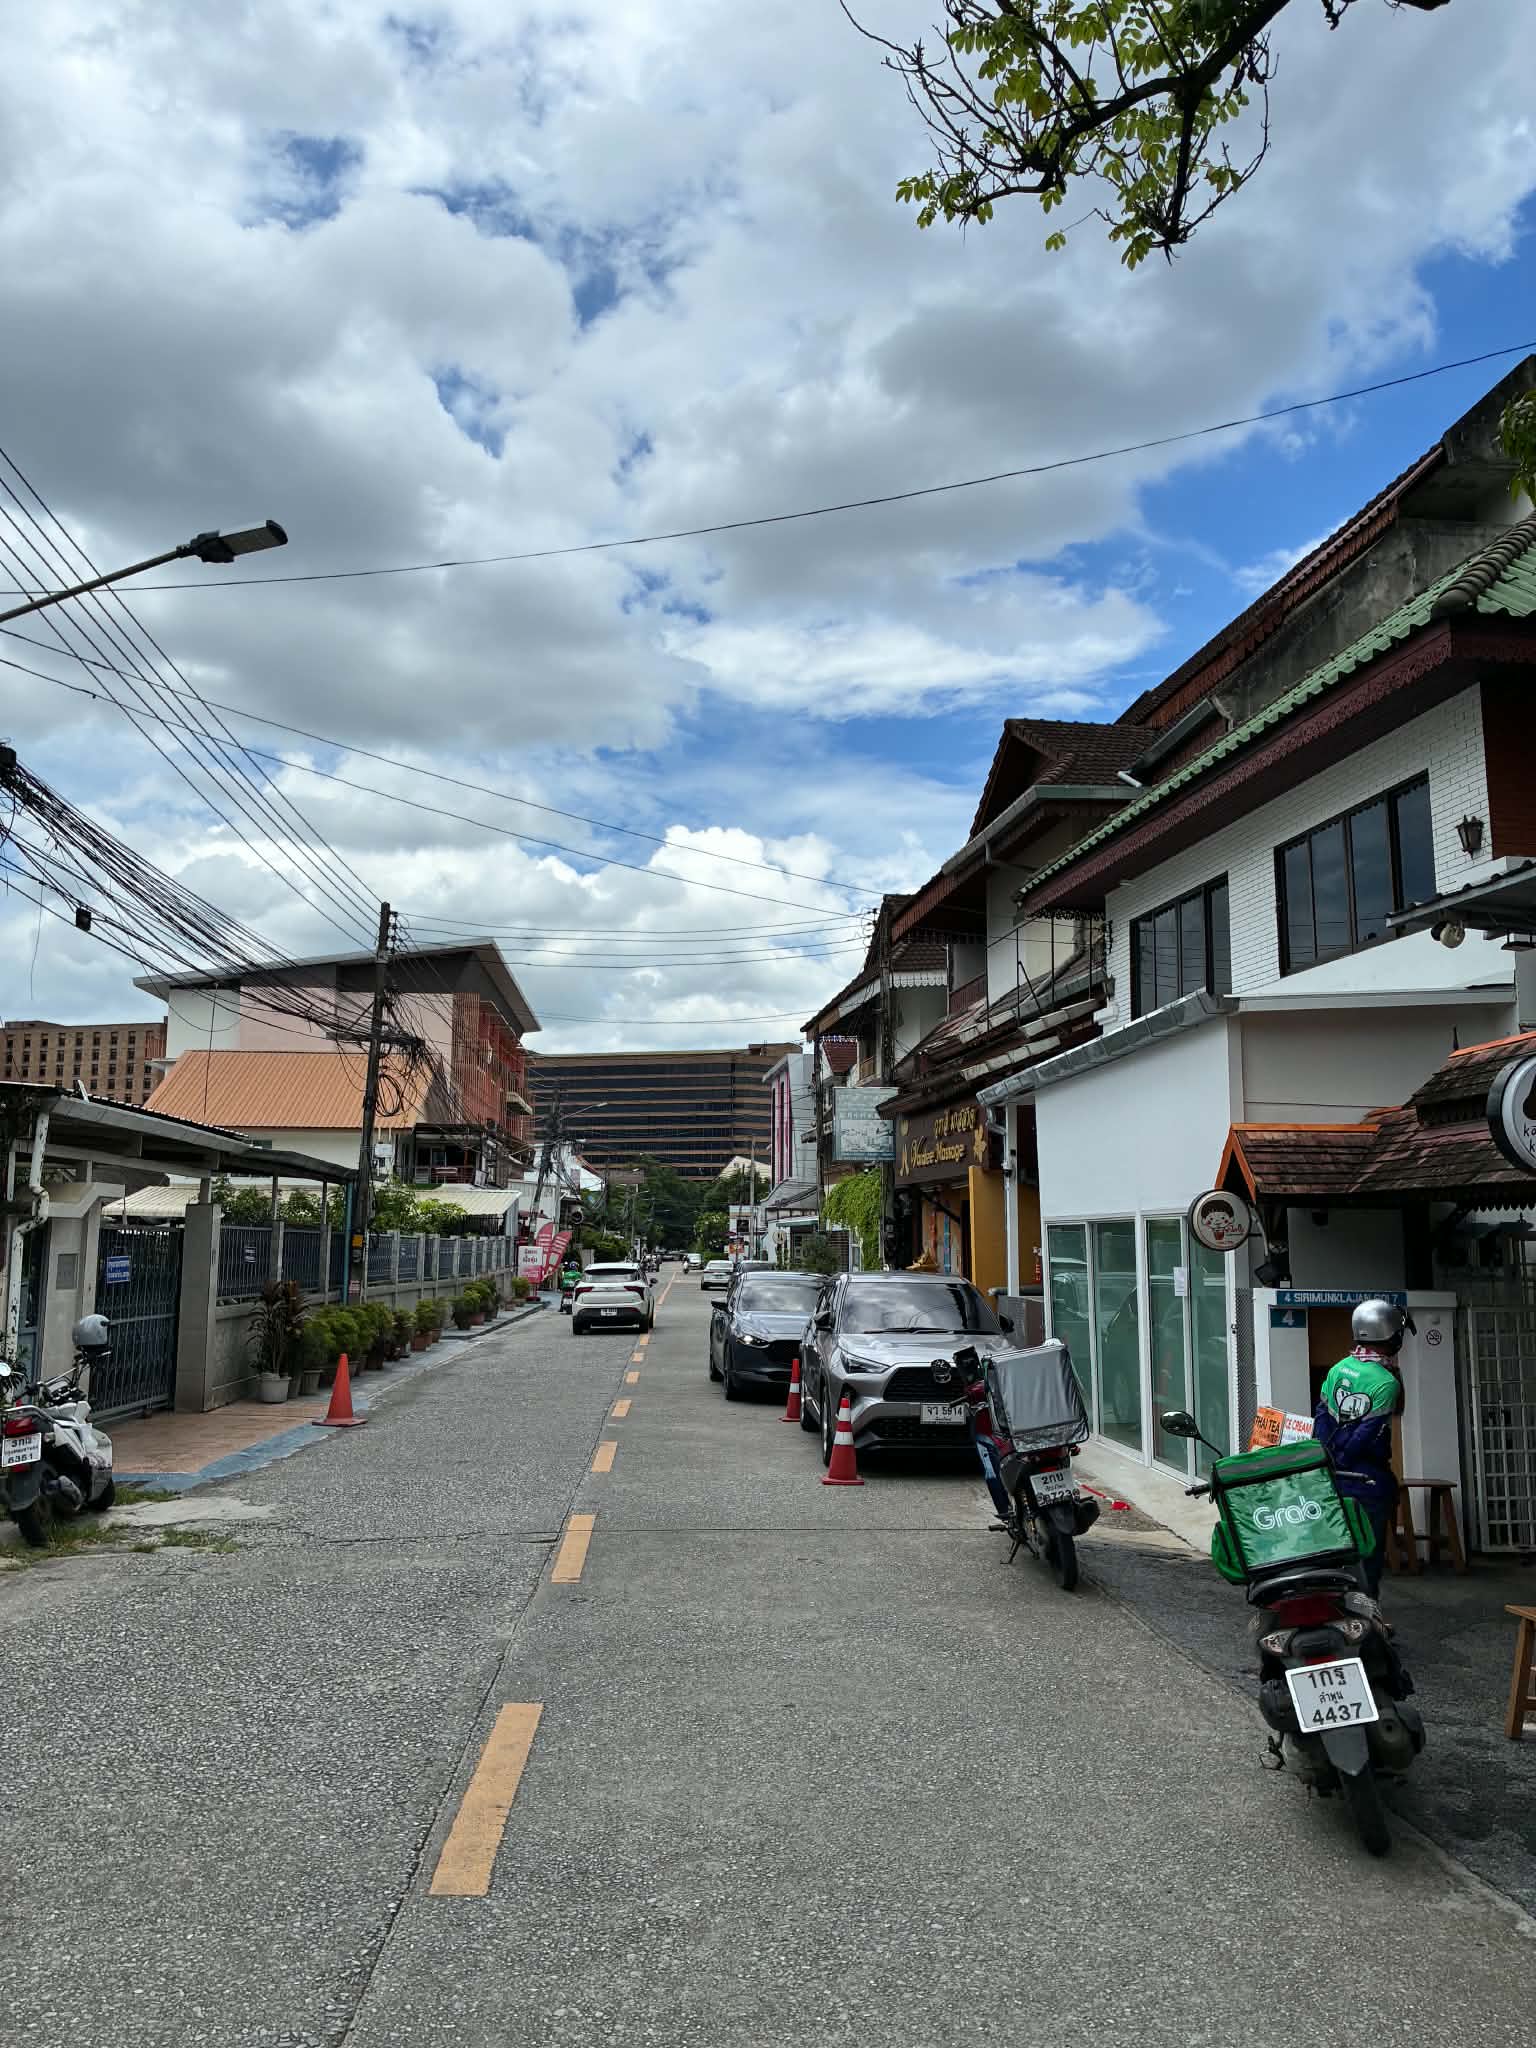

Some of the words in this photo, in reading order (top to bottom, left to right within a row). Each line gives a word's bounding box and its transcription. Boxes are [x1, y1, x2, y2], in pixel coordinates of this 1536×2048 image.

[1284, 1293, 1291, 1302] 4
[1282, 1310, 1295, 1326] 4
[1269, 1419, 1280, 1434] TEA
[1292, 1419, 1313, 1435] CREAM
[1253, 1495, 1322, 1530] Grab
[1312, 1702, 1362, 1725] 4437
